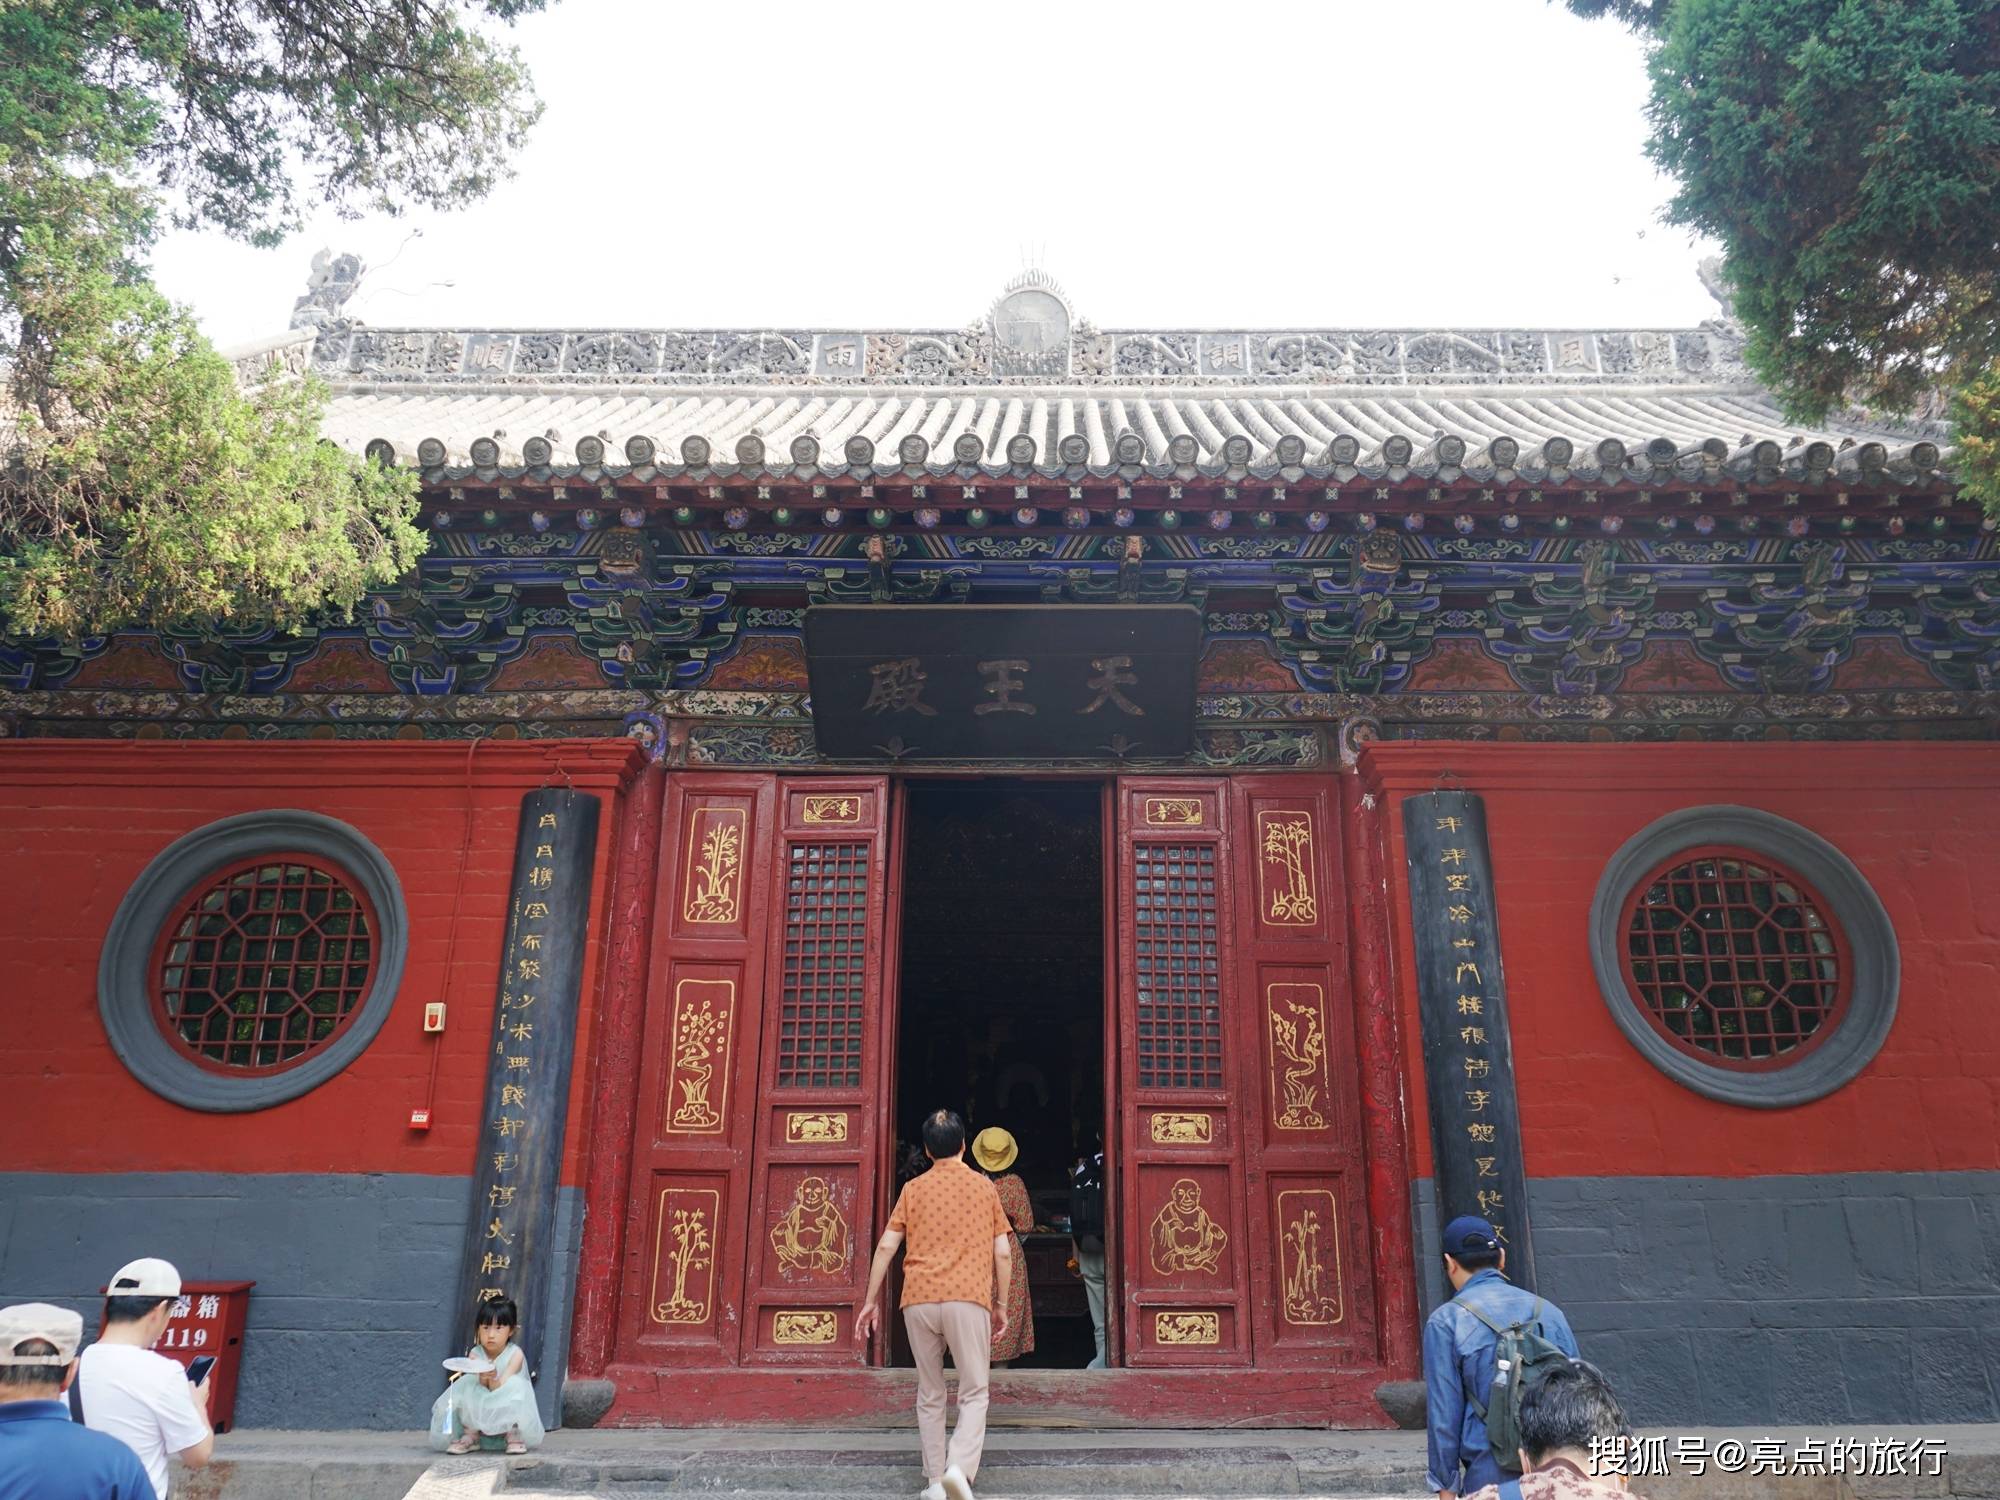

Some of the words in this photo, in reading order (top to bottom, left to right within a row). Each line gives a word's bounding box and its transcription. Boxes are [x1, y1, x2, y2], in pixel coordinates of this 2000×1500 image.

[823, 341, 857, 368] 雨
[861, 655, 1146, 717] 天王殿
[163, 1327, 208, 1347] 119
